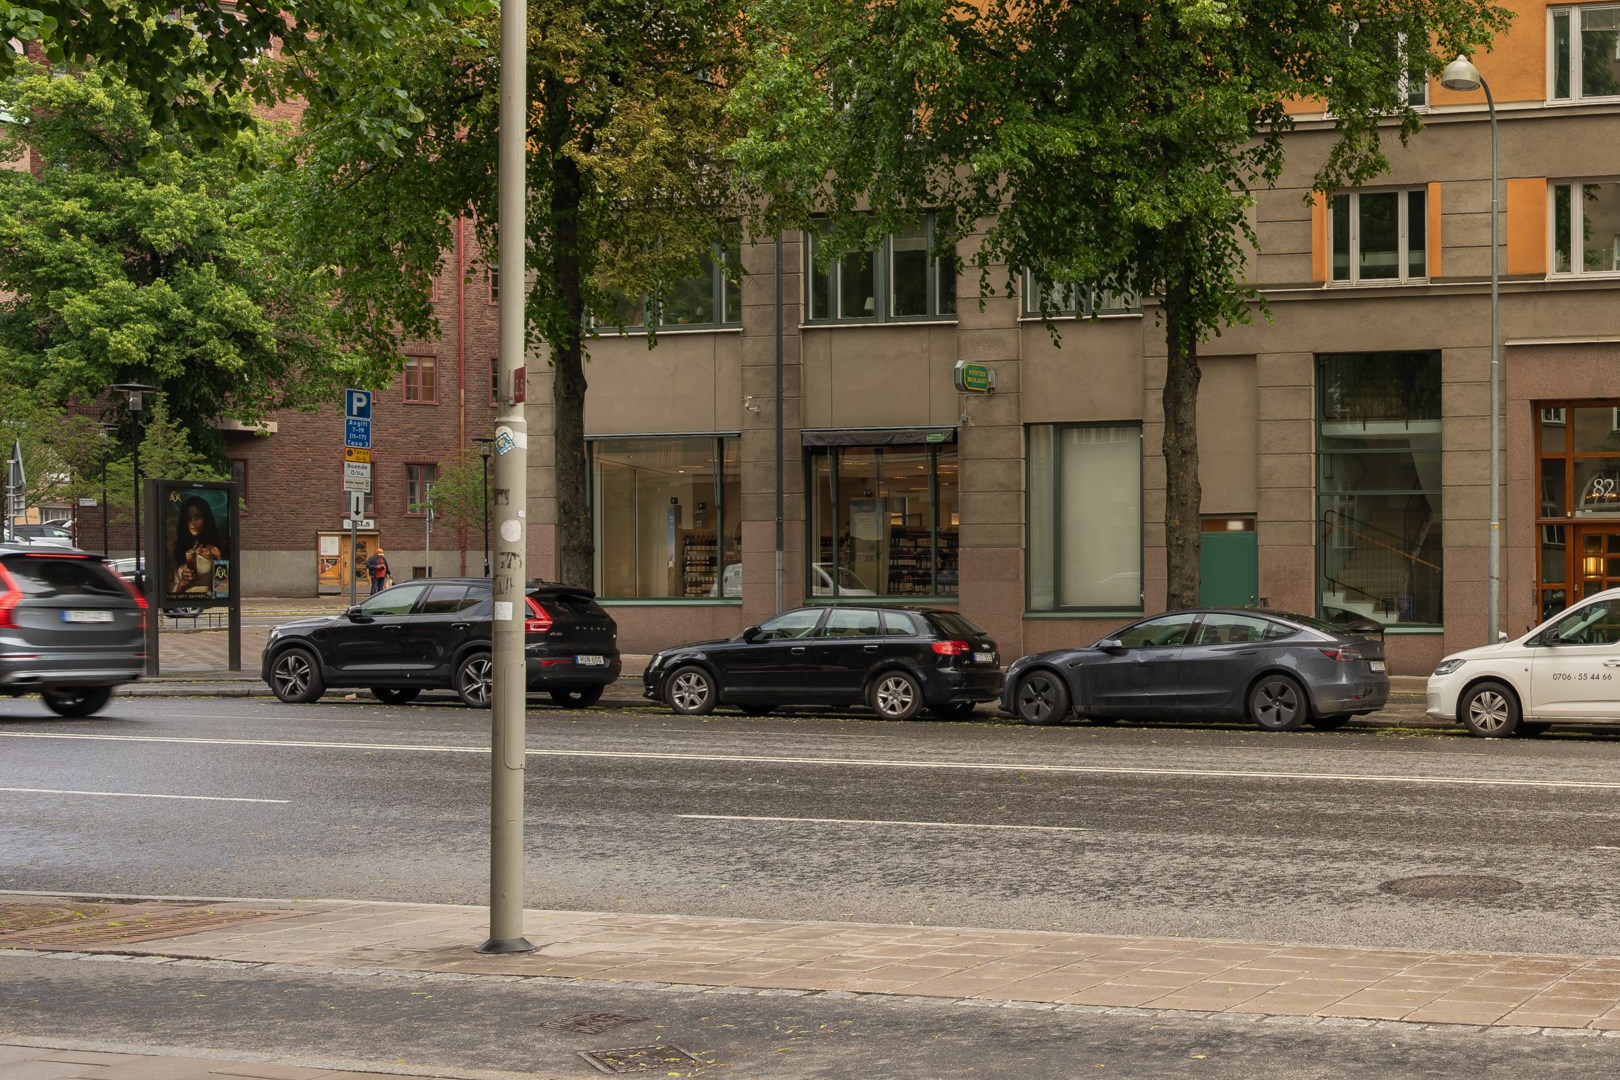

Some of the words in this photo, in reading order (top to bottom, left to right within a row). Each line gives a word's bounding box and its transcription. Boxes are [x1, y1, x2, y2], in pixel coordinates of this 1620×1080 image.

[348, 420, 369, 428] Avgift
[349, 433, 367, 441] (11-17)
[346, 463, 368, 471] Boende
[1593, 478, 1615, 497] 82
[1552, 673, 1572, 681] 0706
[1578, 673, 1588, 681] 55
[1590, 673, 1600, 681] 44
[1602, 673, 1612, 681] 66
